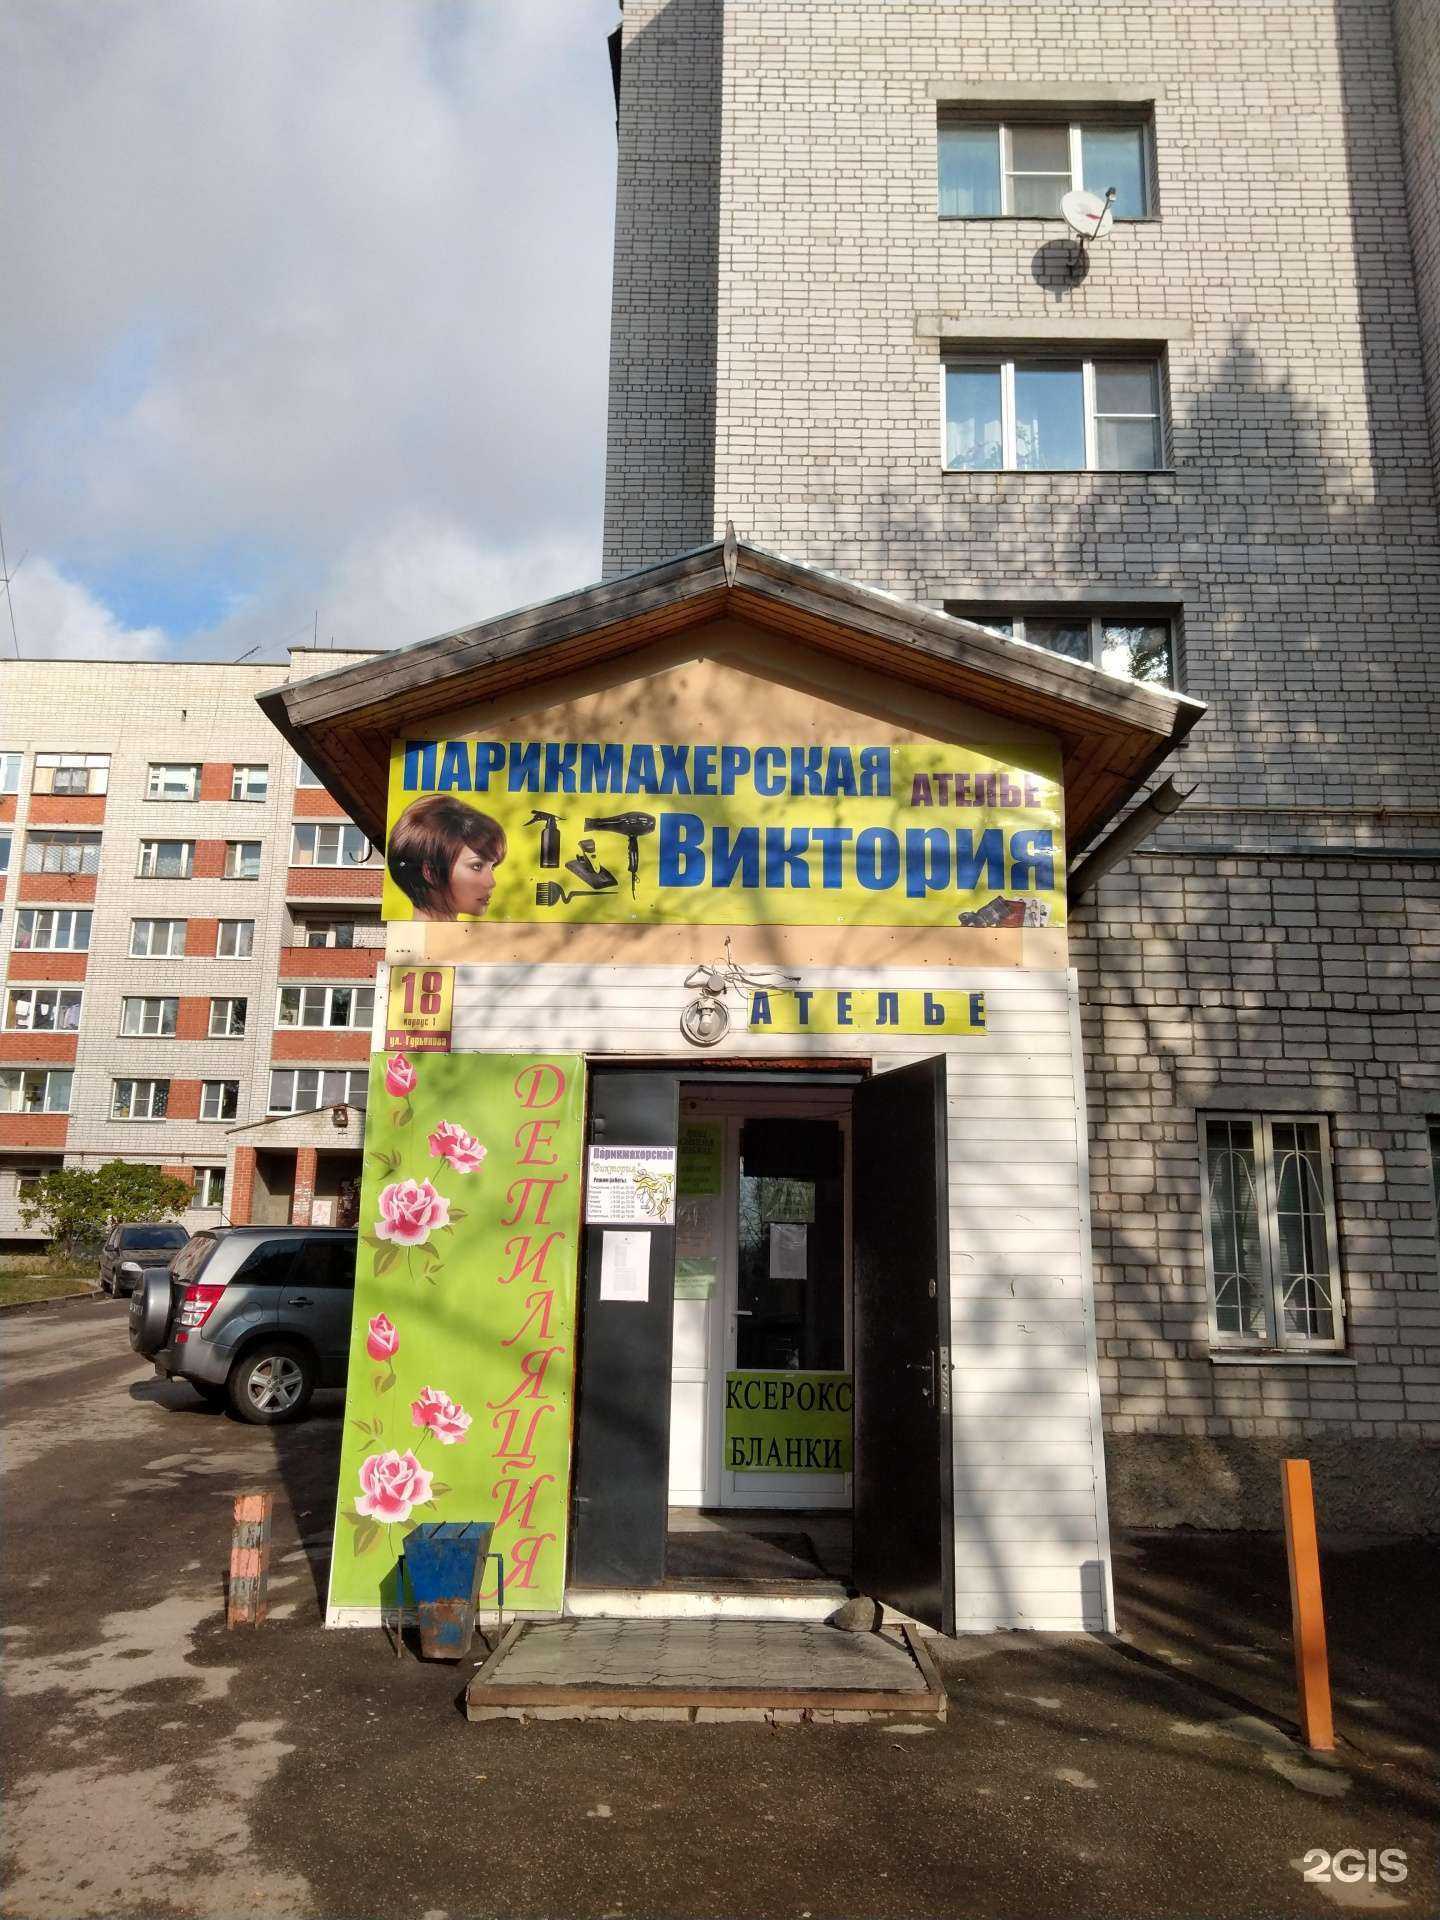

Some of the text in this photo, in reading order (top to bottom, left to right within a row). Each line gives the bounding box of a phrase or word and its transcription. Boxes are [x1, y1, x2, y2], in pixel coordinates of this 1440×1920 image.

[403, 740, 891, 797] ПАРИКМАХЕРСКАЯ
[910, 772, 1042, 809] АТЕЛЬЕ
[658, 812, 1055, 899] Виктория
[401, 971, 443, 1014] 18
[750, 991, 986, 1027] АТЕЛЬЕ
[389, 1036, 402, 1048] ул.
[479, 1063, 568, 1600] ДЕПИЛЯЦИЯ
[725, 1379, 852, 1412] КСЕРОКС
[730, 1437, 842, 1468] БЛАНКИ
